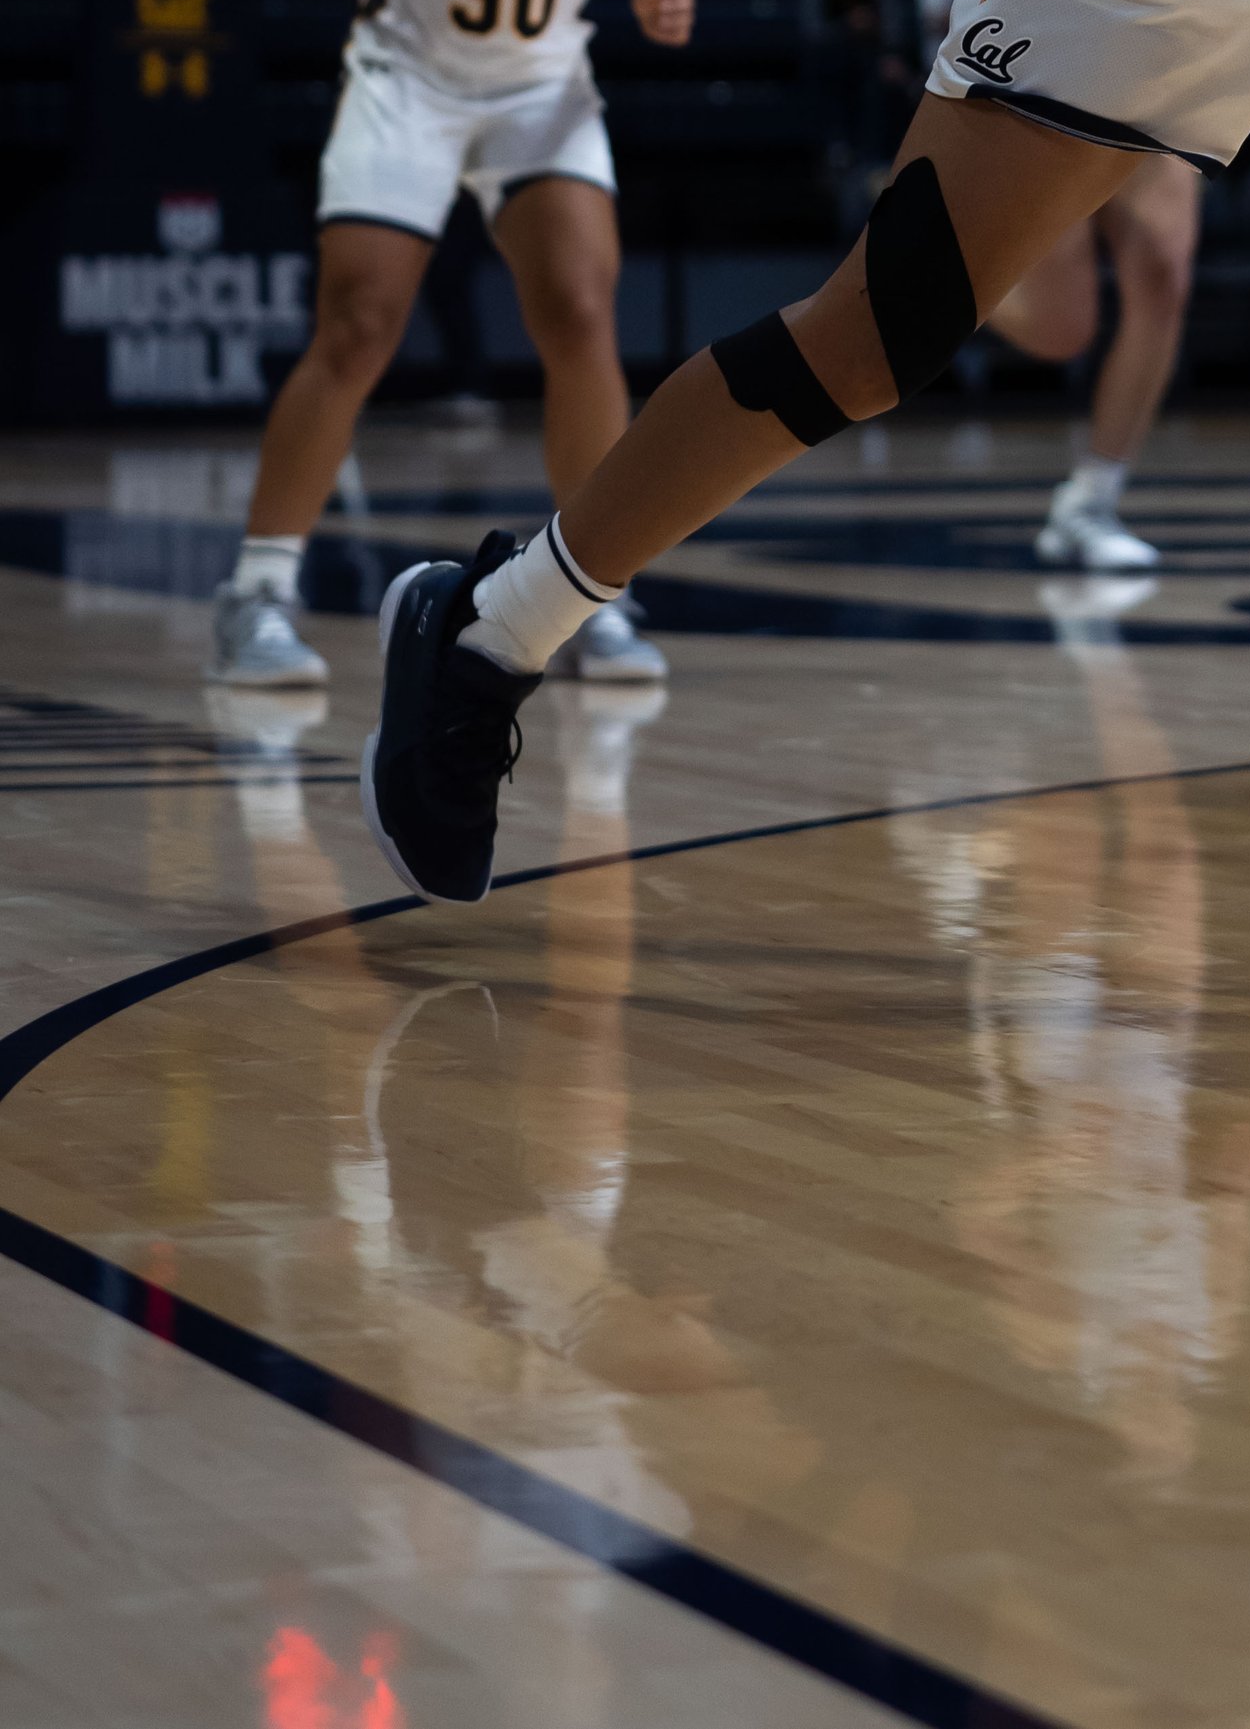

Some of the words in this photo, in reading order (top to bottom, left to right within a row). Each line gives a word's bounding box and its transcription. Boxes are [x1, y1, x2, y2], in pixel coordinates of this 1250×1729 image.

[955, 17, 1032, 85] Cal
[61, 253, 308, 332] MUSCLE
[108, 327, 264, 406] MILK
